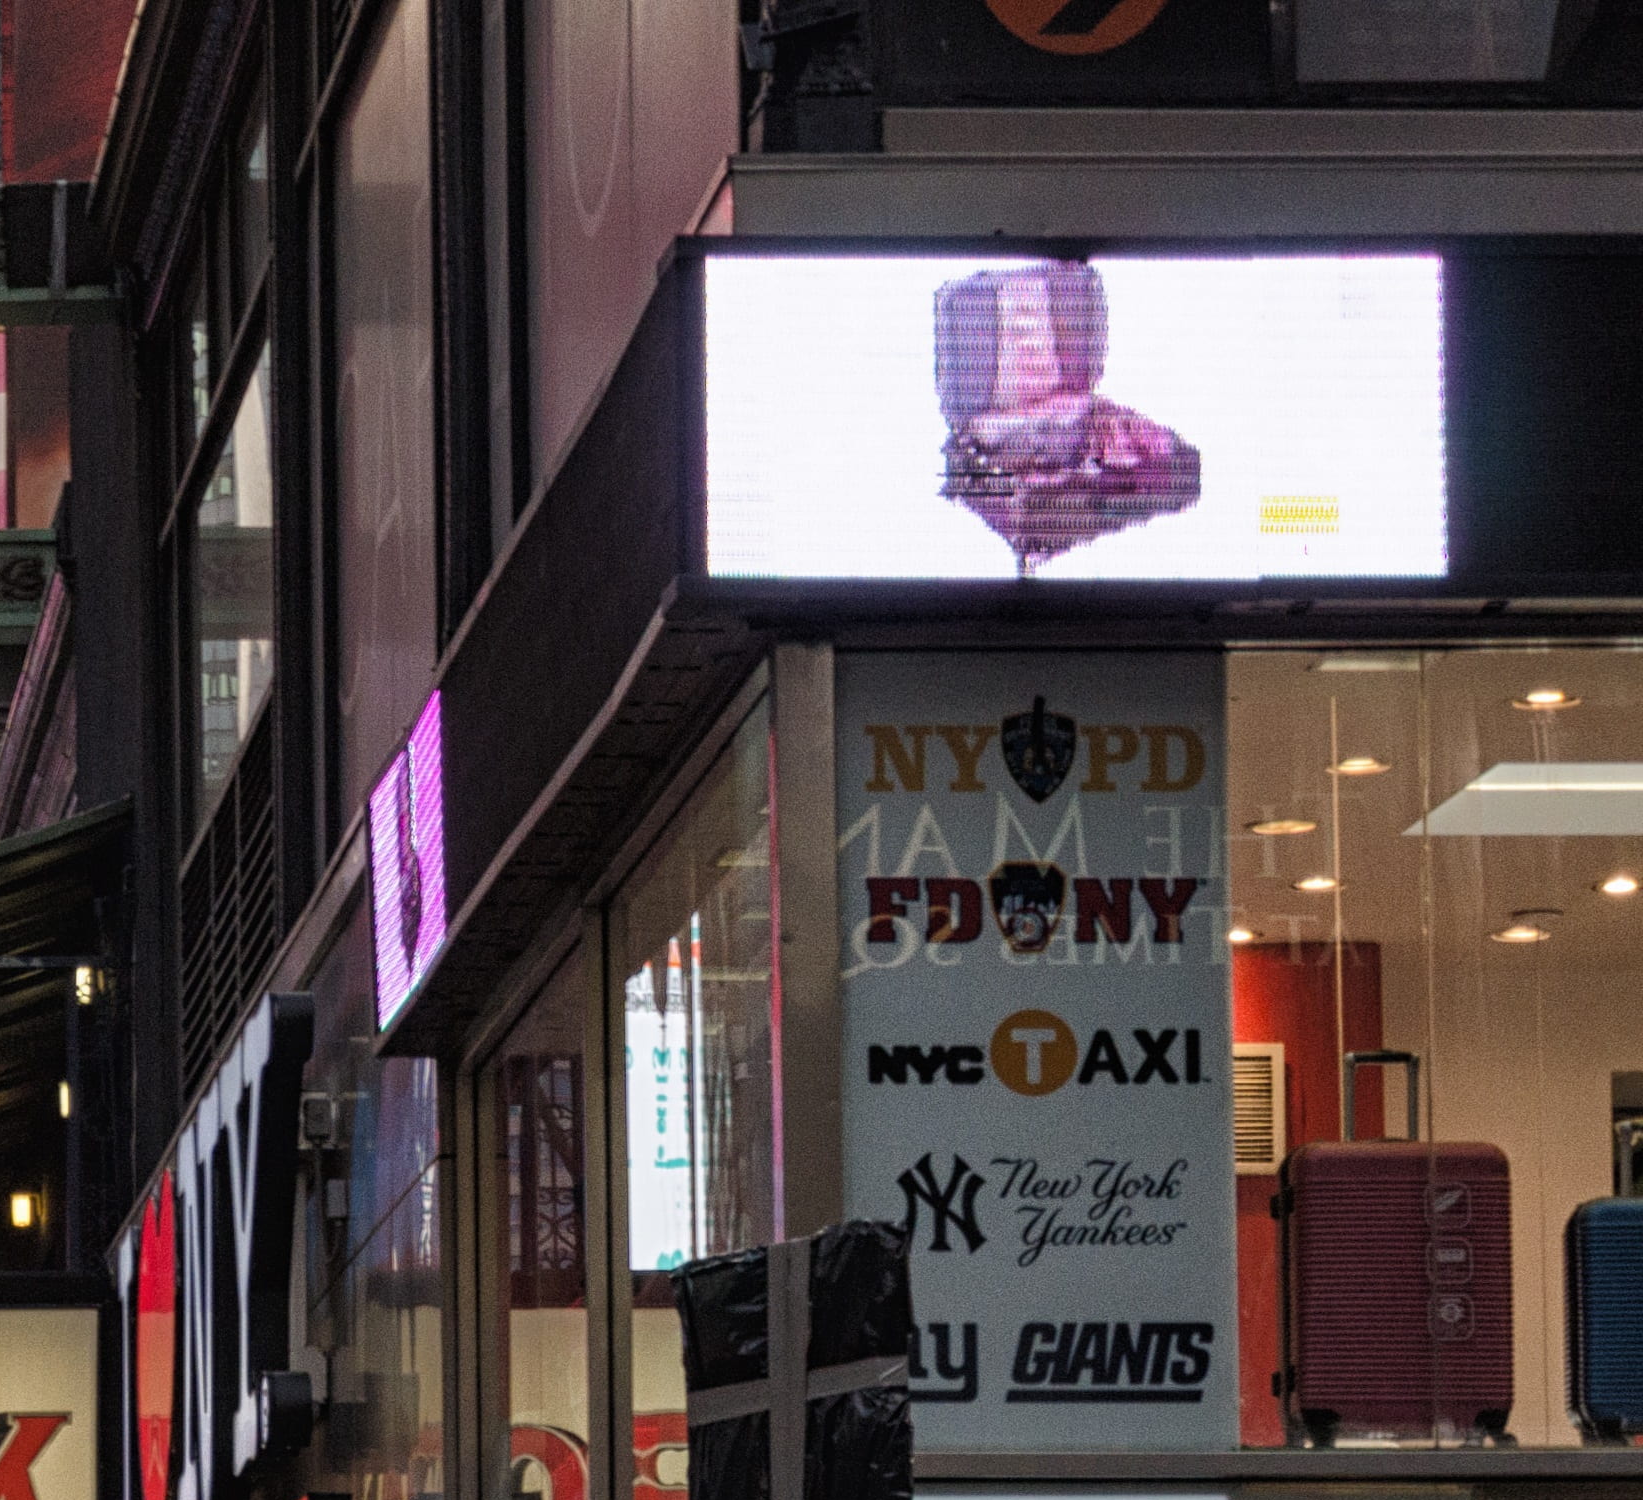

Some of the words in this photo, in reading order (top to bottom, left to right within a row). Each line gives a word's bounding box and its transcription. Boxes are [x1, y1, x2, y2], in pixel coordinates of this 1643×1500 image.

[868, 1044, 985, 1086] NYC
[1005, 1027, 1203, 1090] TAXI
[990, 1159, 1082, 1200] New
[1085, 1159, 1188, 1220] York
[1016, 1206, 1178, 1268] Yankees
[1011, 1323, 1213, 1386] GIANTS
